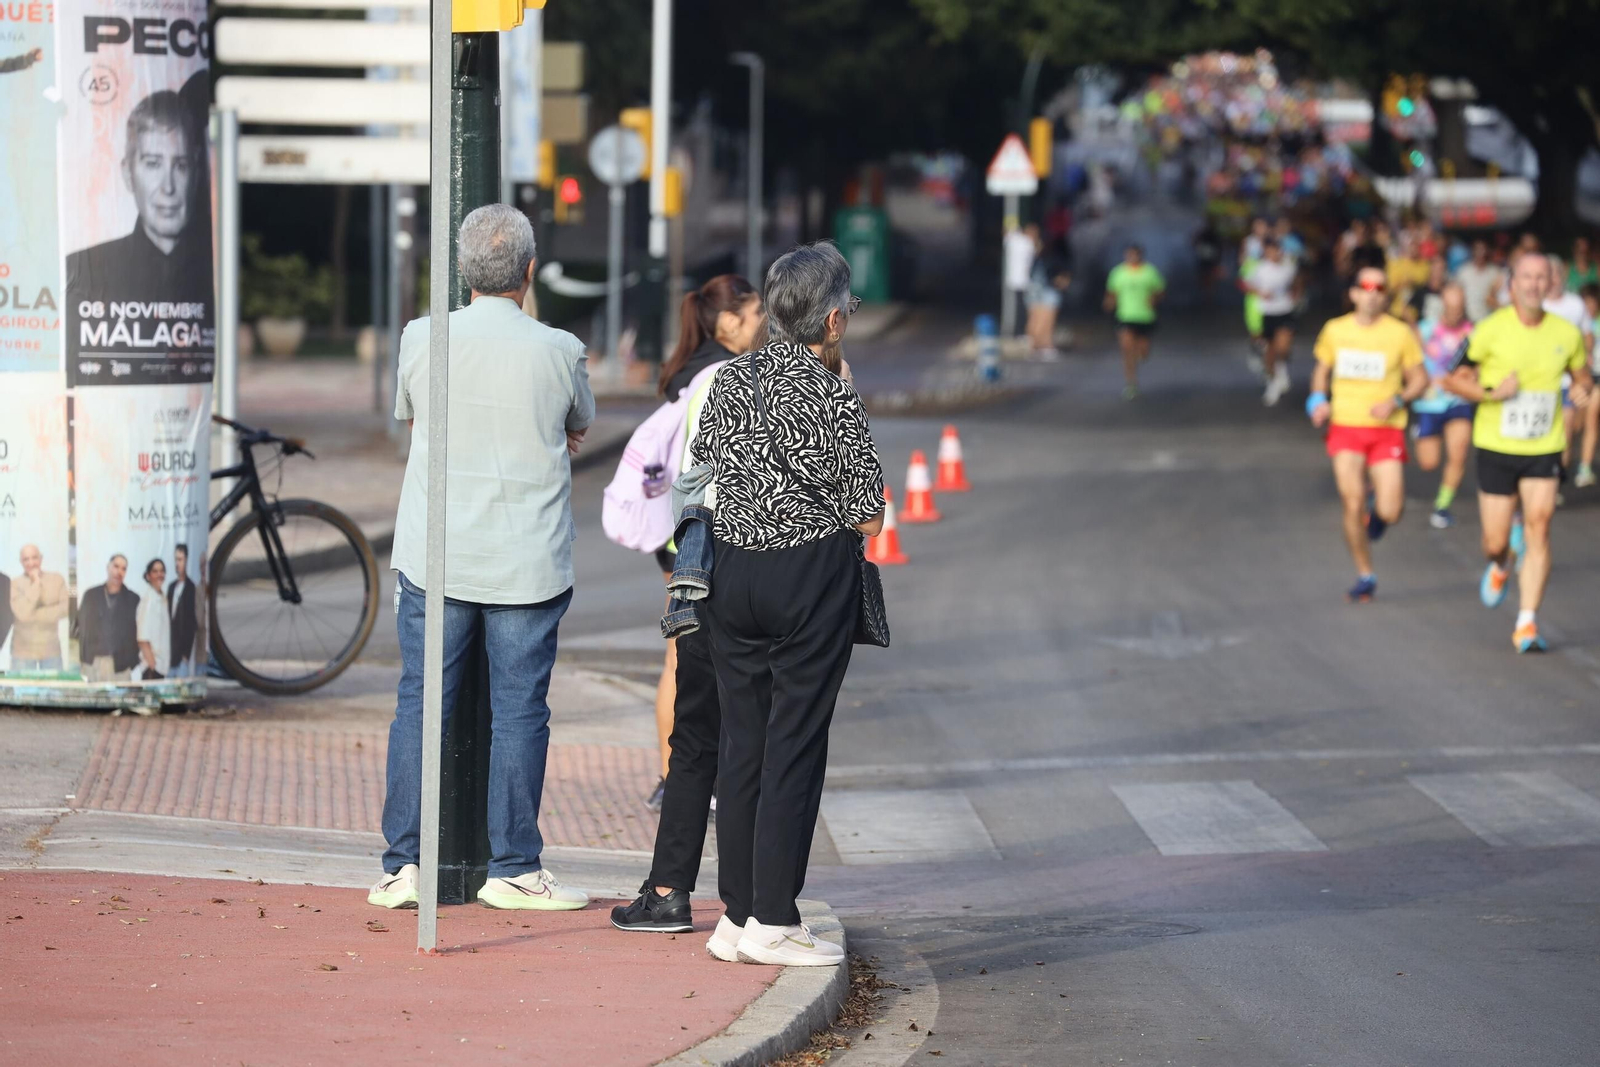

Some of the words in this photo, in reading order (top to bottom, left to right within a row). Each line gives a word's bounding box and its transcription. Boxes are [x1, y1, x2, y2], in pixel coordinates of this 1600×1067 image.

[0, 0, 54, 23] UÉ?
[88, 76, 111, 92] 45
[110, 302, 205, 319] NOVIEMBRE
[80, 316, 201, 347] MÁLAGA
